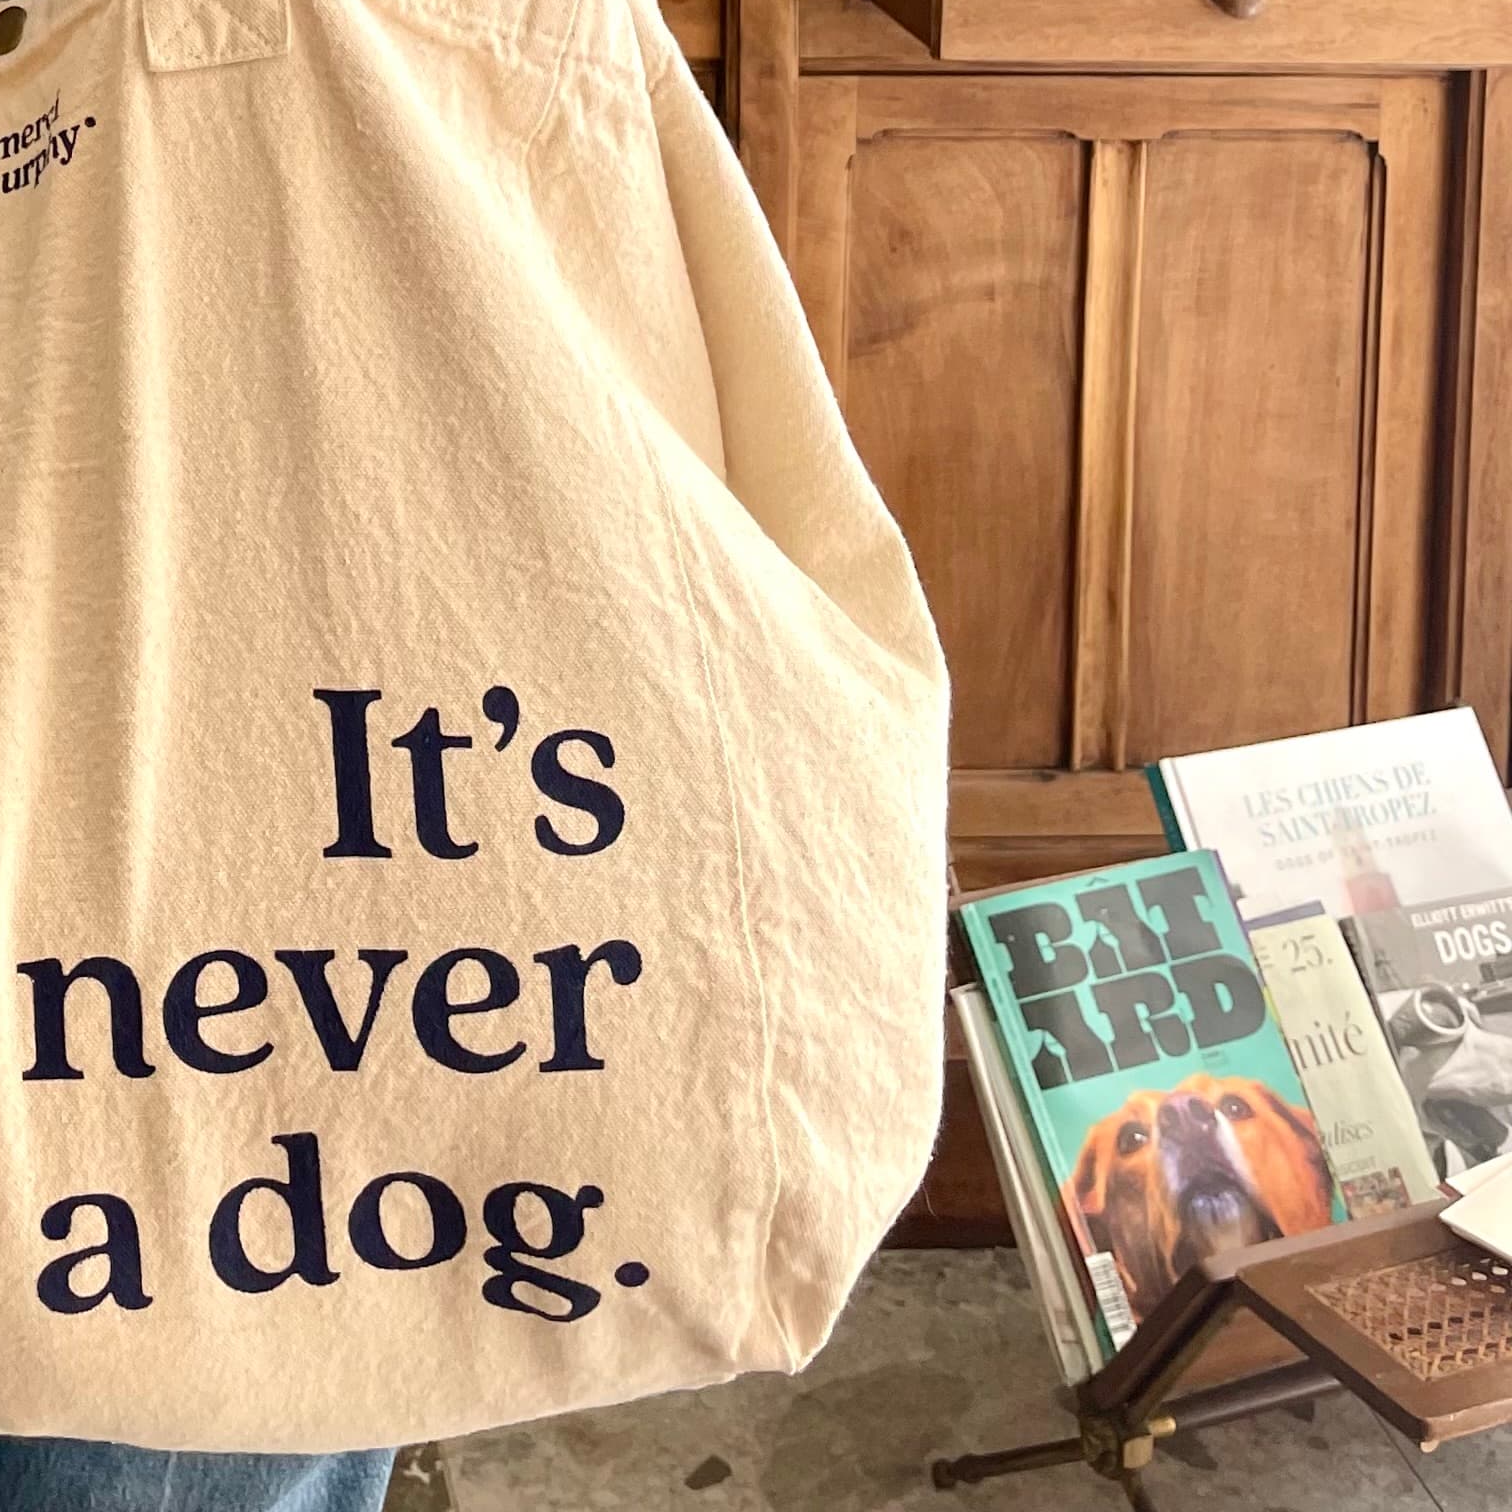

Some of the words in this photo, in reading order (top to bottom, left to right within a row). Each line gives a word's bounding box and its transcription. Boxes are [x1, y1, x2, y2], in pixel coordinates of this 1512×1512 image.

[312, 685, 626, 860] It's
[1243, 787, 1293, 820] LES
[1297, 772, 1388, 808] CHIENS
[1393, 761, 1432, 789] DE
[17, 940, 644, 1081] never
[1433, 920, 1512, 964] DOGS
[37, 1192, 153, 1315] a
[207, 1131, 650, 1324] dog.
